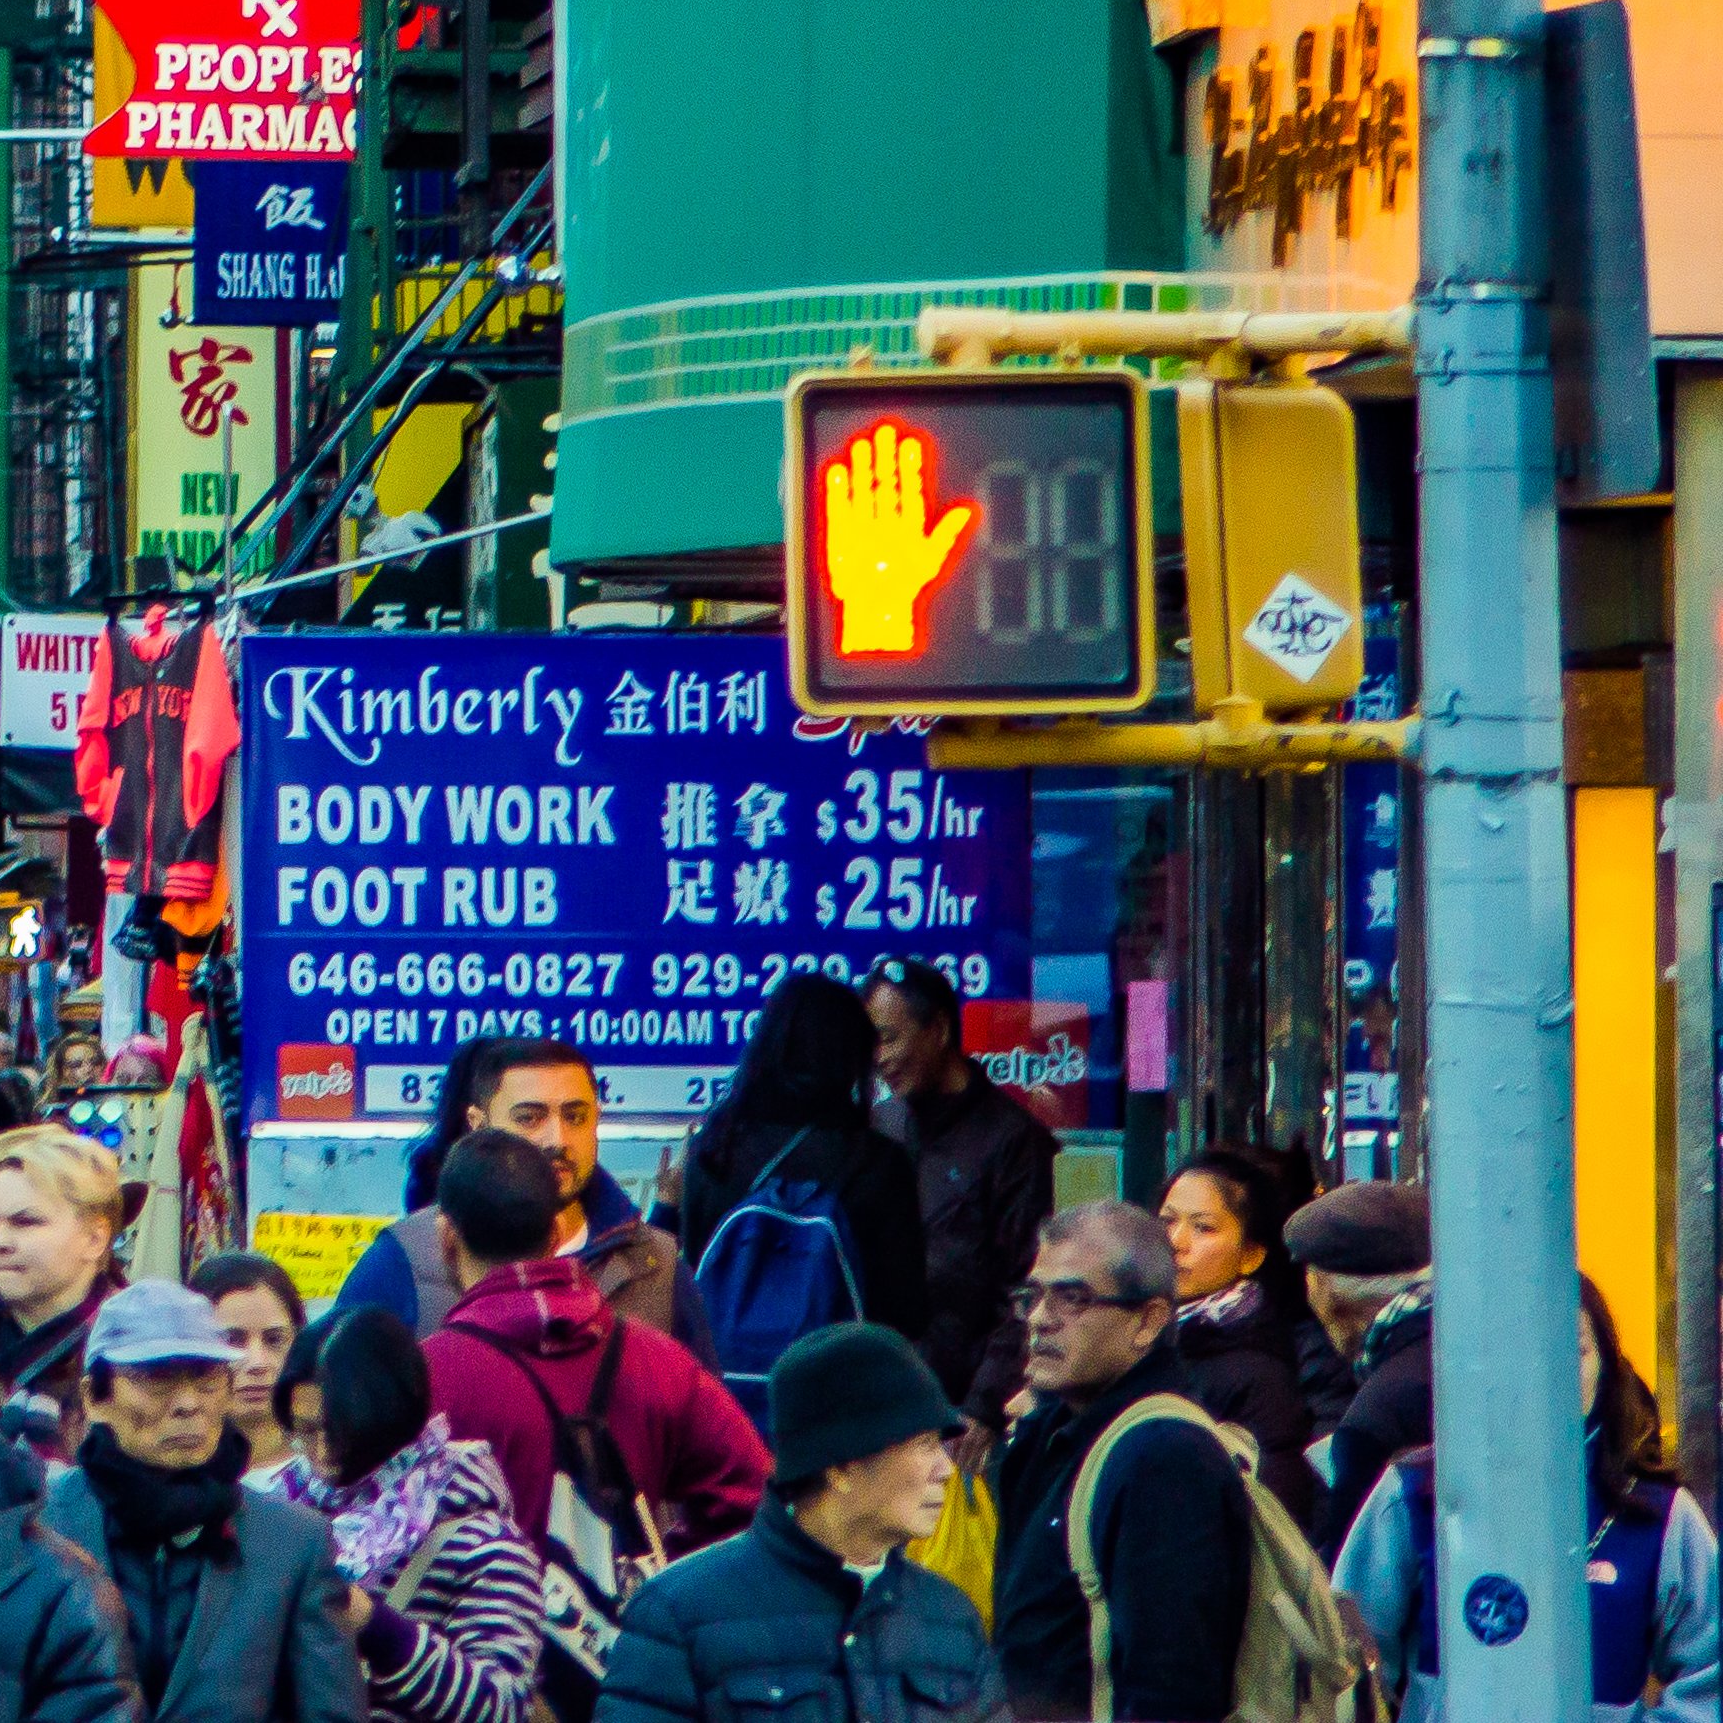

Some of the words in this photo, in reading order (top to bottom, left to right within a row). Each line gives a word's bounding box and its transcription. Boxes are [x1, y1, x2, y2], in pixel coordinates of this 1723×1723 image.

[216, 253, 296, 300] SHANG
[264, 665, 583, 767] Kimberly
[603, 669, 768, 736] 金伯利
[277, 785, 432, 845] BODY
[446, 785, 617, 845] WORK
[661, 781, 790, 850] 推拿
[815, 769, 985, 845] $35/hr
[277, 866, 427, 926] FOOT
[443, 866, 558, 926] RUB
[814, 856, 979, 932] $25/hr
[287, 953, 626, 997] 646-666-0827
[325, 1008, 420, 1045] OPEN
[427, 1009, 448, 1045] 7
[570, 1009, 714, 1045] 10:00AM
